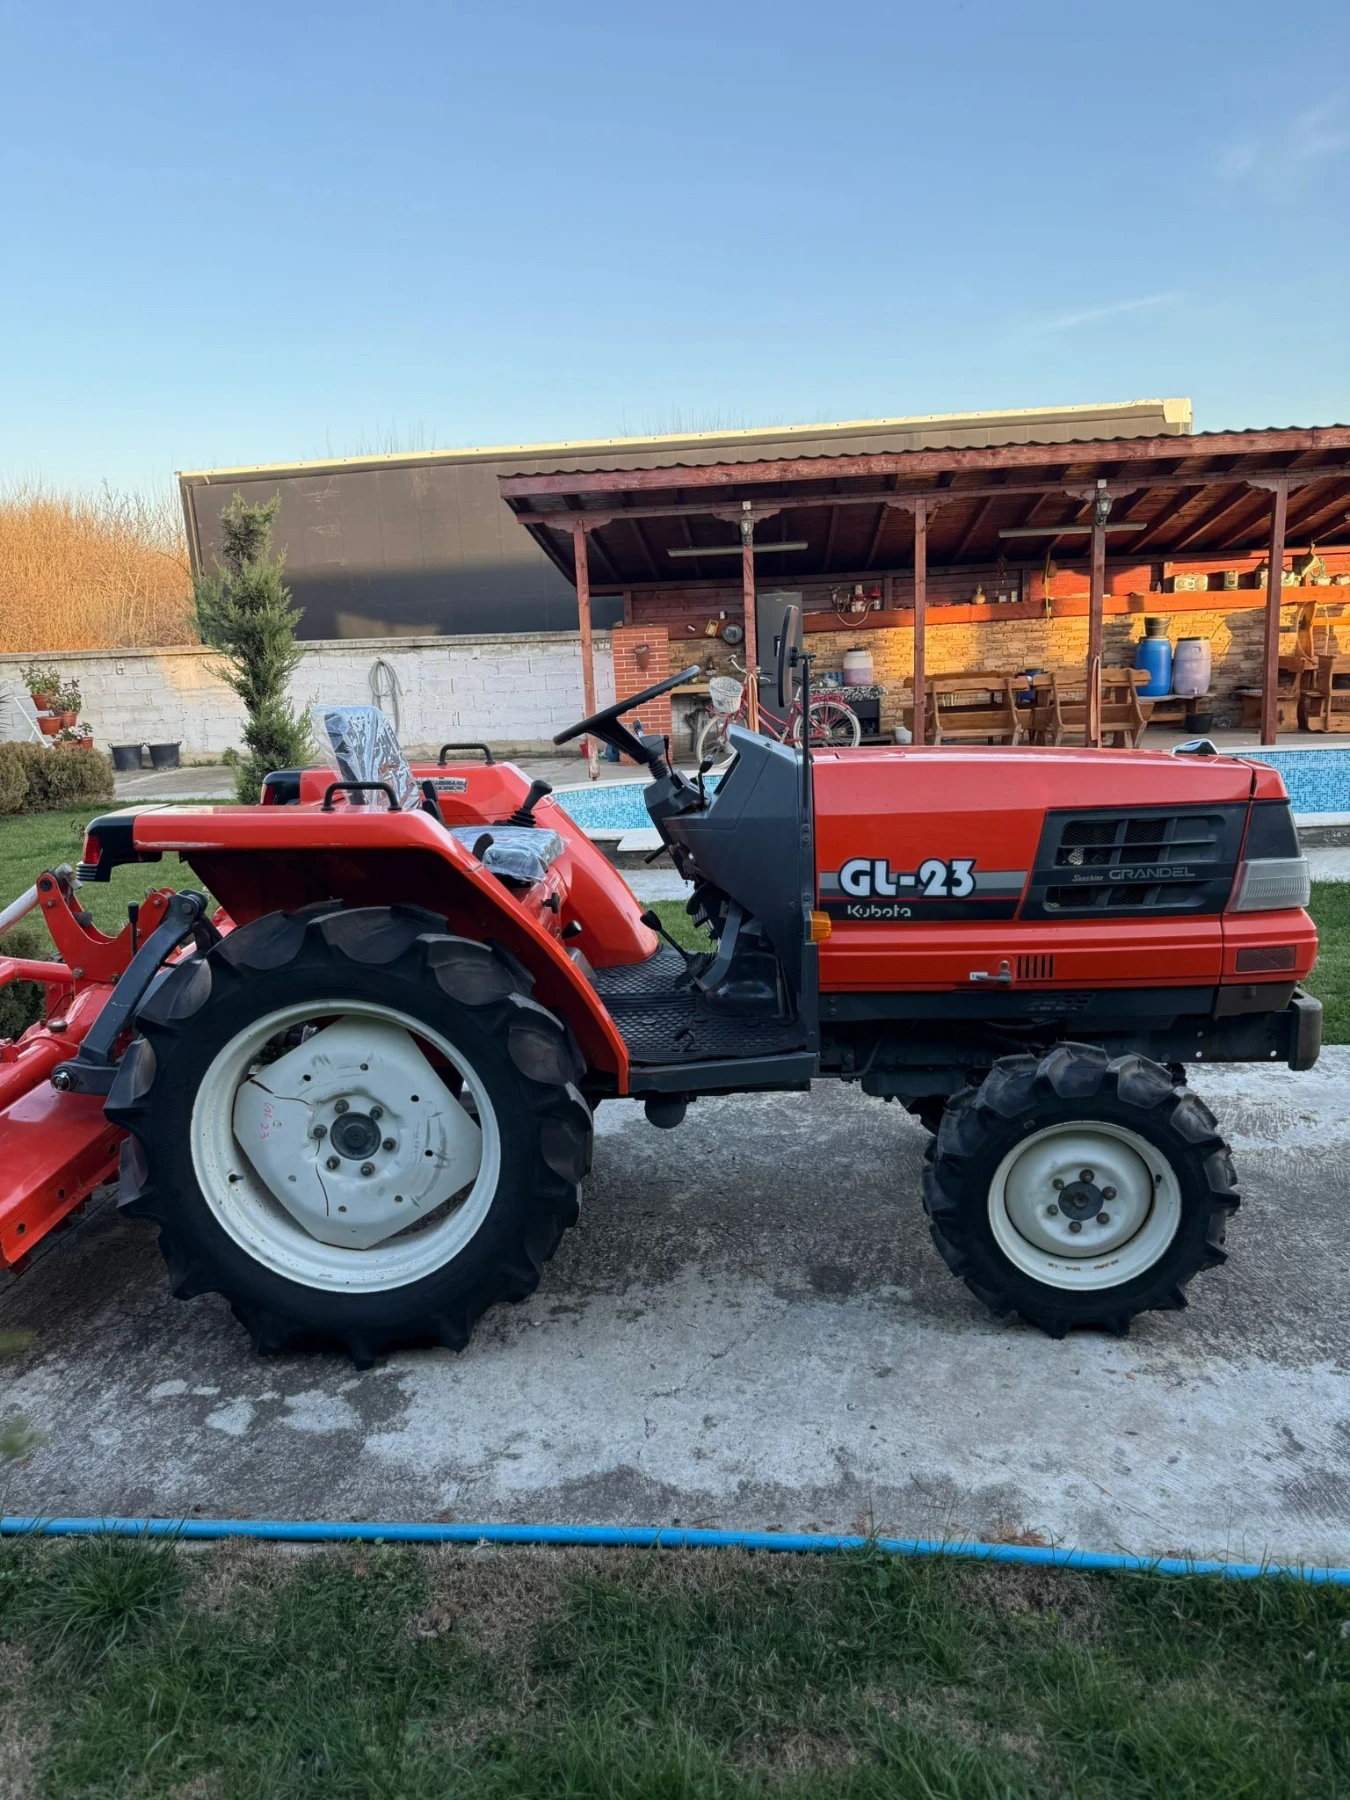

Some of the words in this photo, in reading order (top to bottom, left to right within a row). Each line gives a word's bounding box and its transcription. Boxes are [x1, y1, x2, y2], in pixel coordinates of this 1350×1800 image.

[839, 858, 976, 899] GL-23
[1109, 866, 1197, 880] GRANDEL
[847, 904, 912, 918] Kubota
